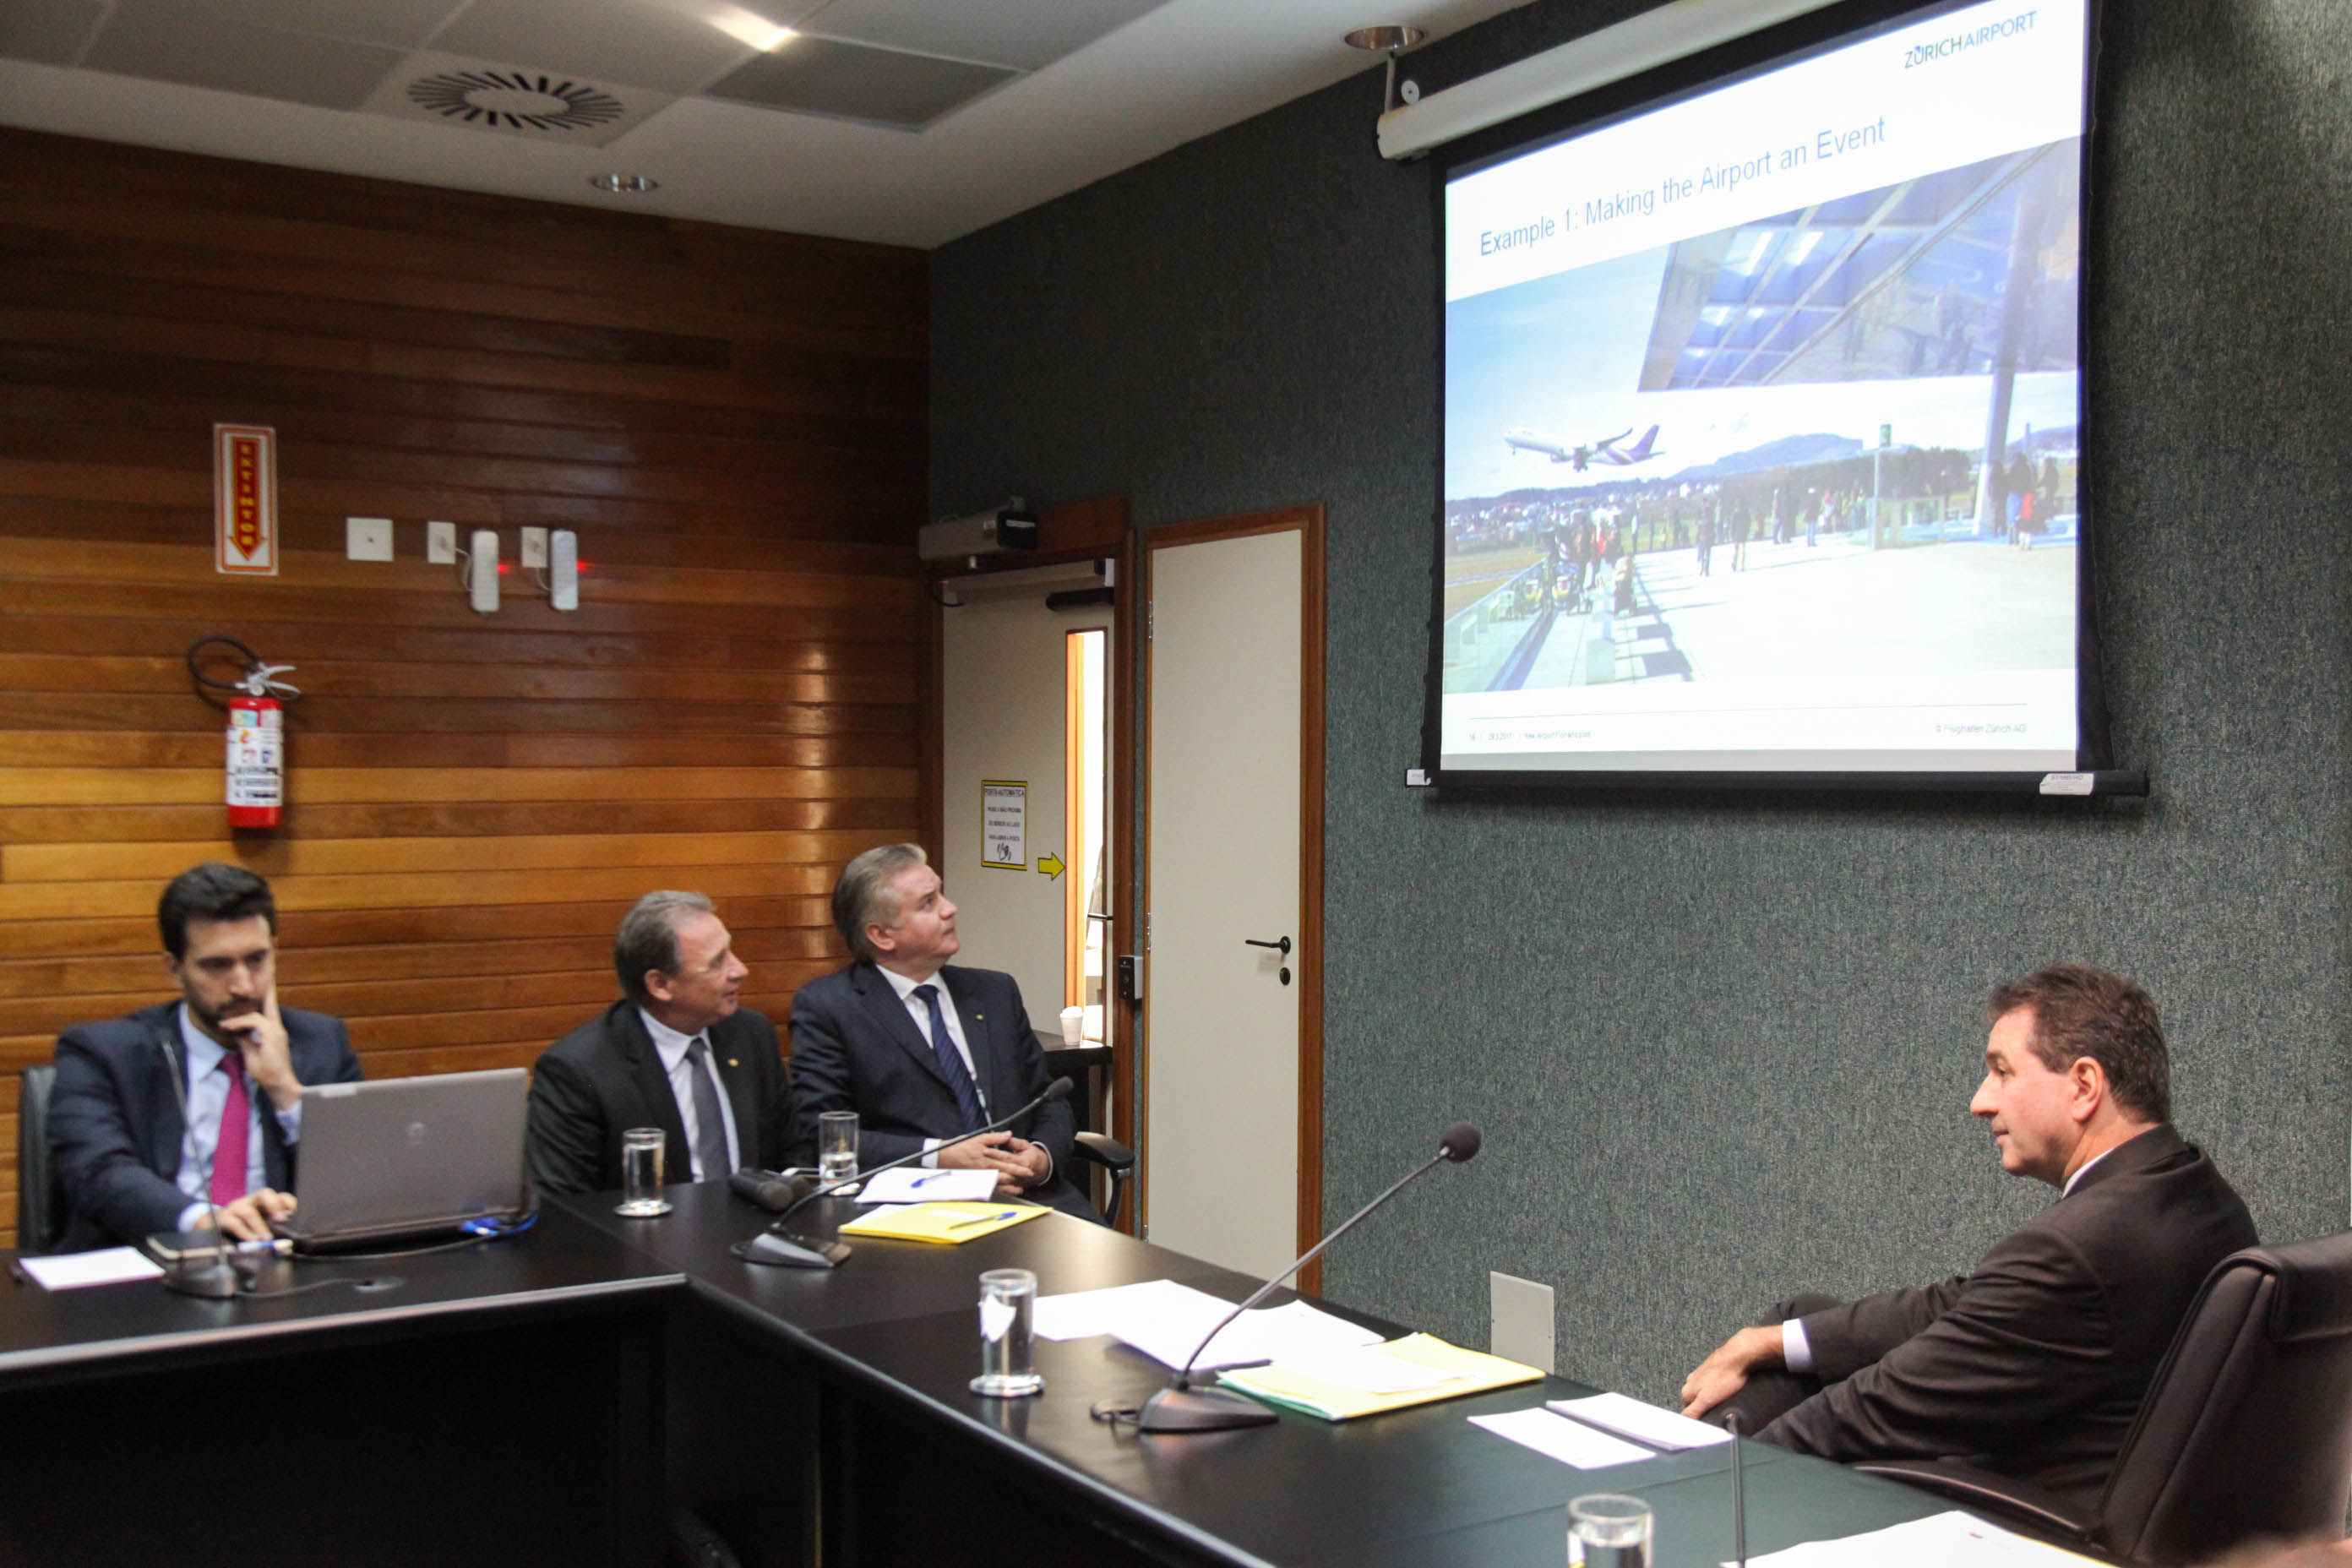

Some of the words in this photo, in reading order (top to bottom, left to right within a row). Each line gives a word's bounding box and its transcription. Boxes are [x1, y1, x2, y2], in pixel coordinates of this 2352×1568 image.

[1480, 215, 1555, 256] Example
[1563, 209, 1579, 232] 1:
[1586, 188, 1655, 226] Making
[1663, 176, 1693, 204] the
[1700, 153, 1772, 193] Airport
[1780, 144, 1807, 171] an
[1816, 116, 1886, 161] Event
